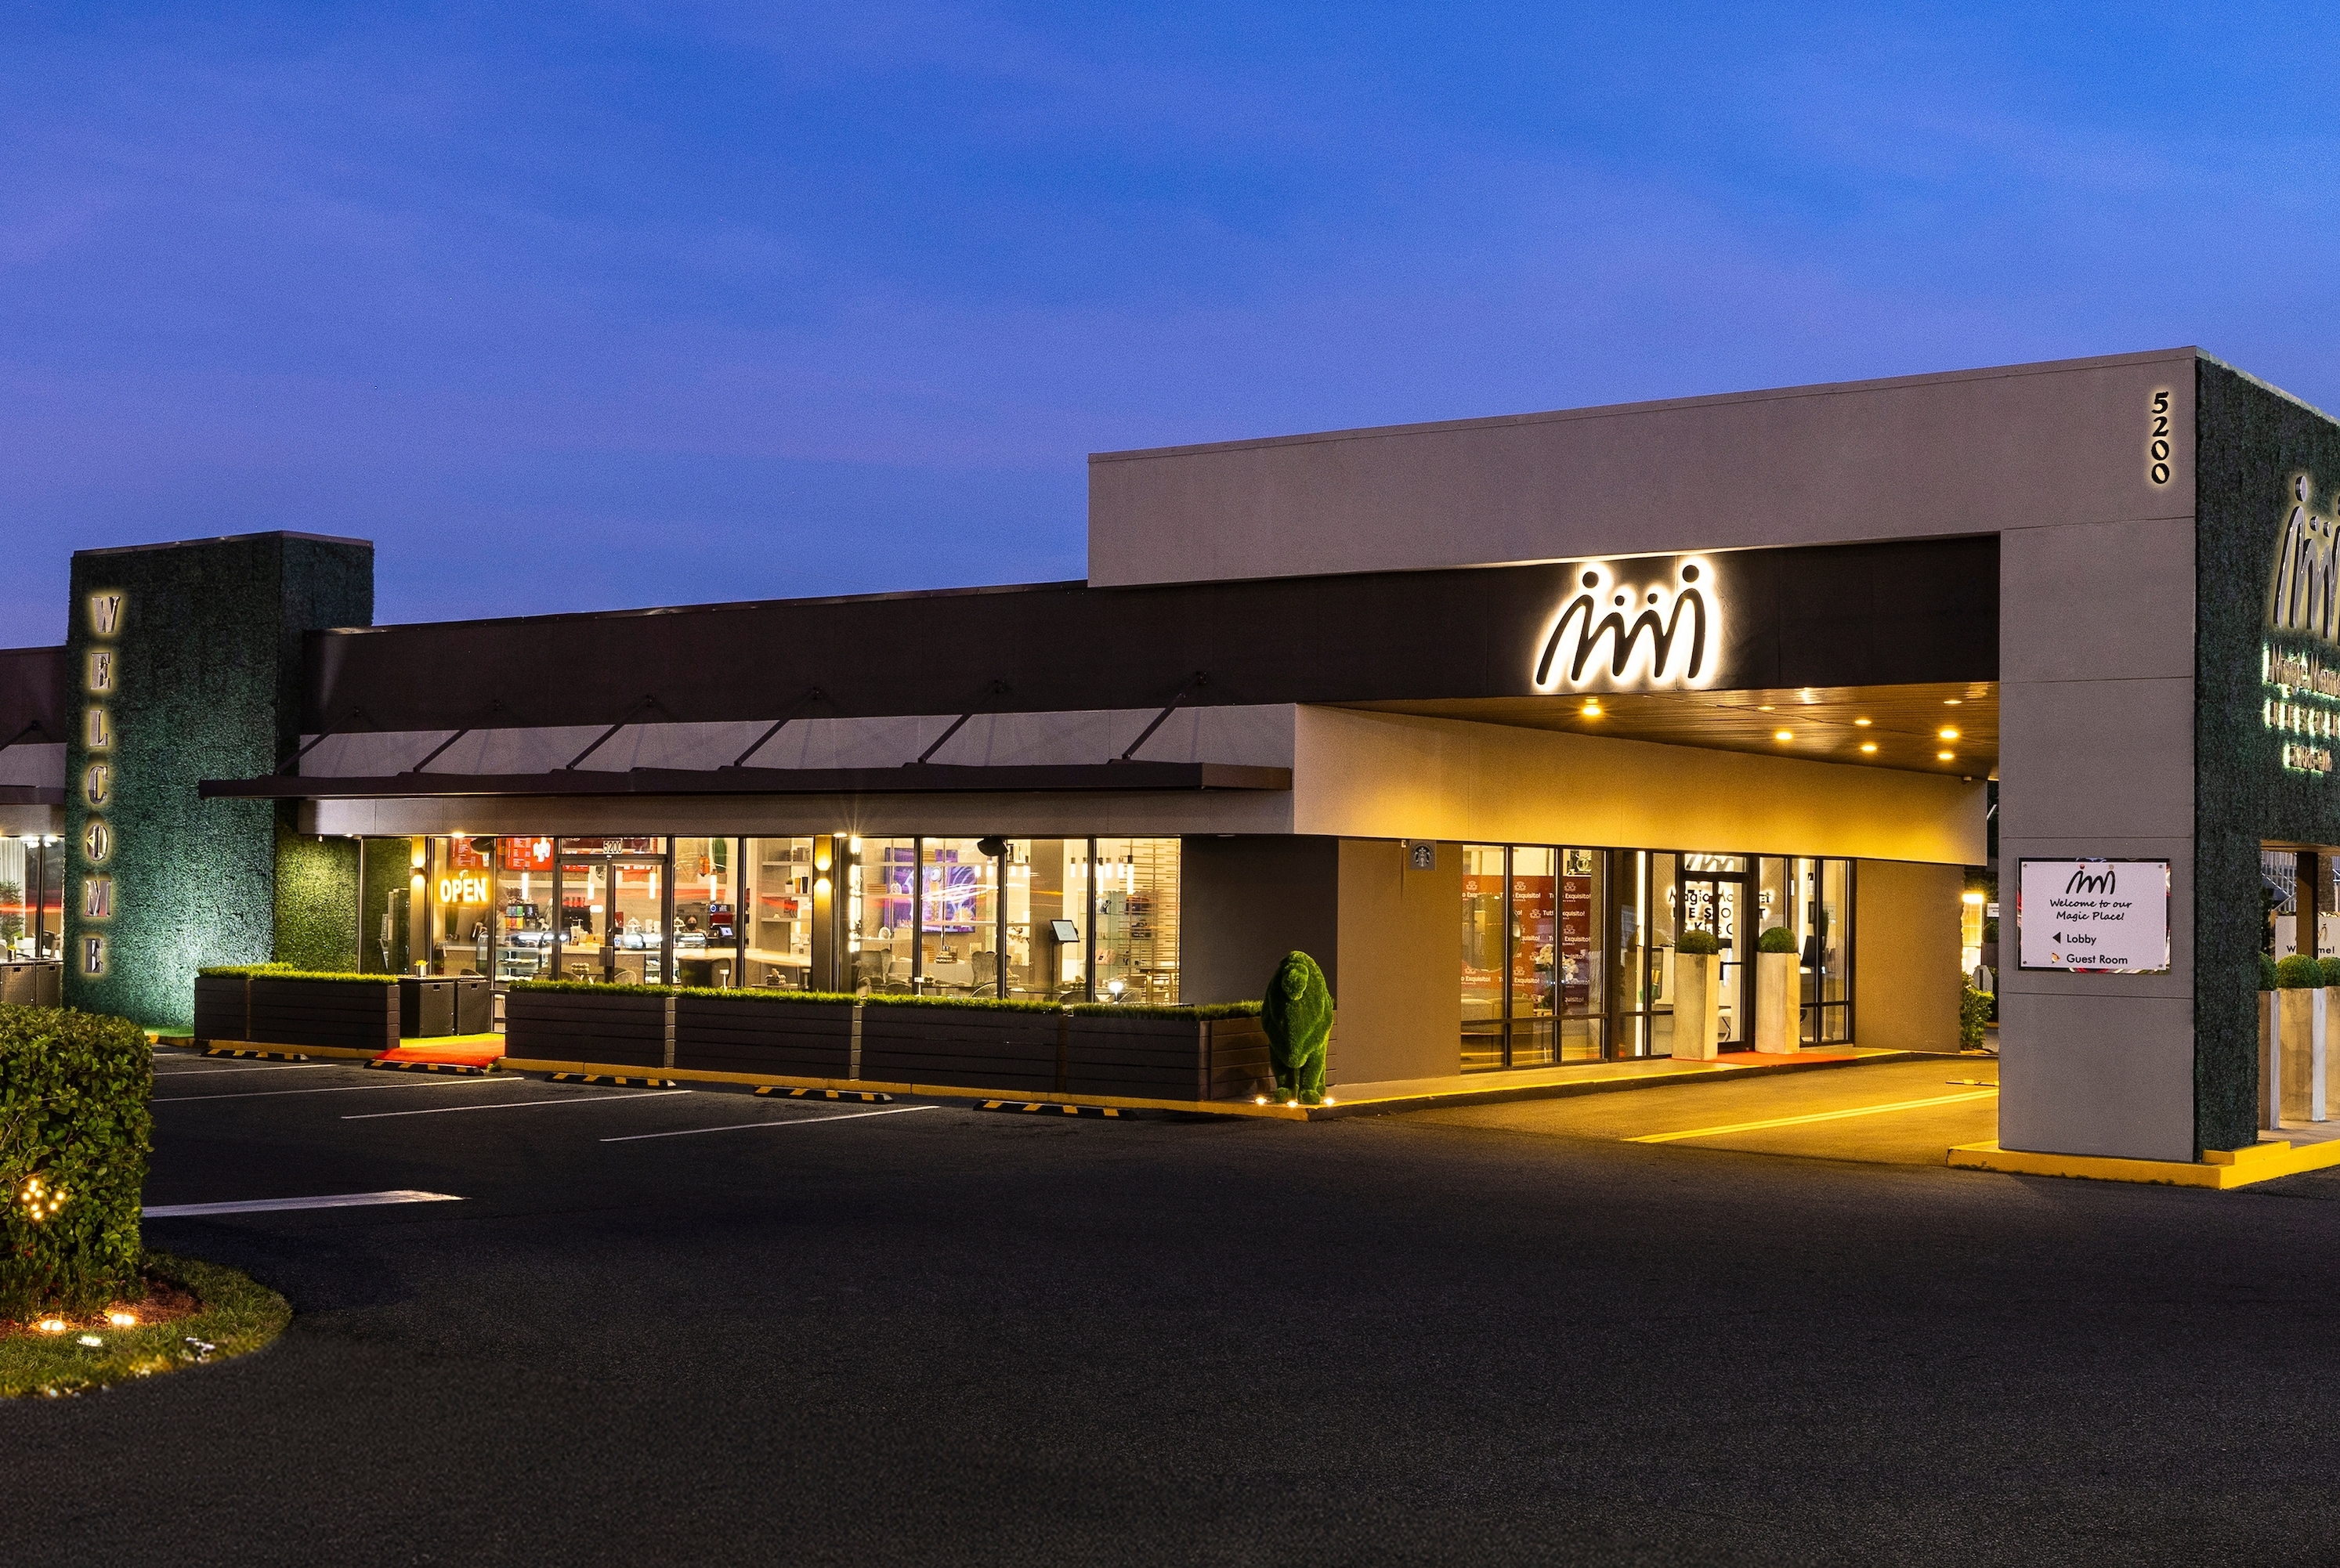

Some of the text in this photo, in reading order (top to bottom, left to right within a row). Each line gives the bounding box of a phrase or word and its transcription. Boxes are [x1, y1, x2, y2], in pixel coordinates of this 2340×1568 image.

[2150, 391, 2170, 484] 5200
[84, 595, 121, 974] WELCOME
[604, 841, 622, 853] 5200
[439, 877, 488, 903] OPEN
[2049, 898, 2097, 908] Welcome
[2056, 911, 2125, 922] Magic Place!
[2067, 934, 2096, 945] Lobby
[2066, 953, 2128, 964] Guest Room
